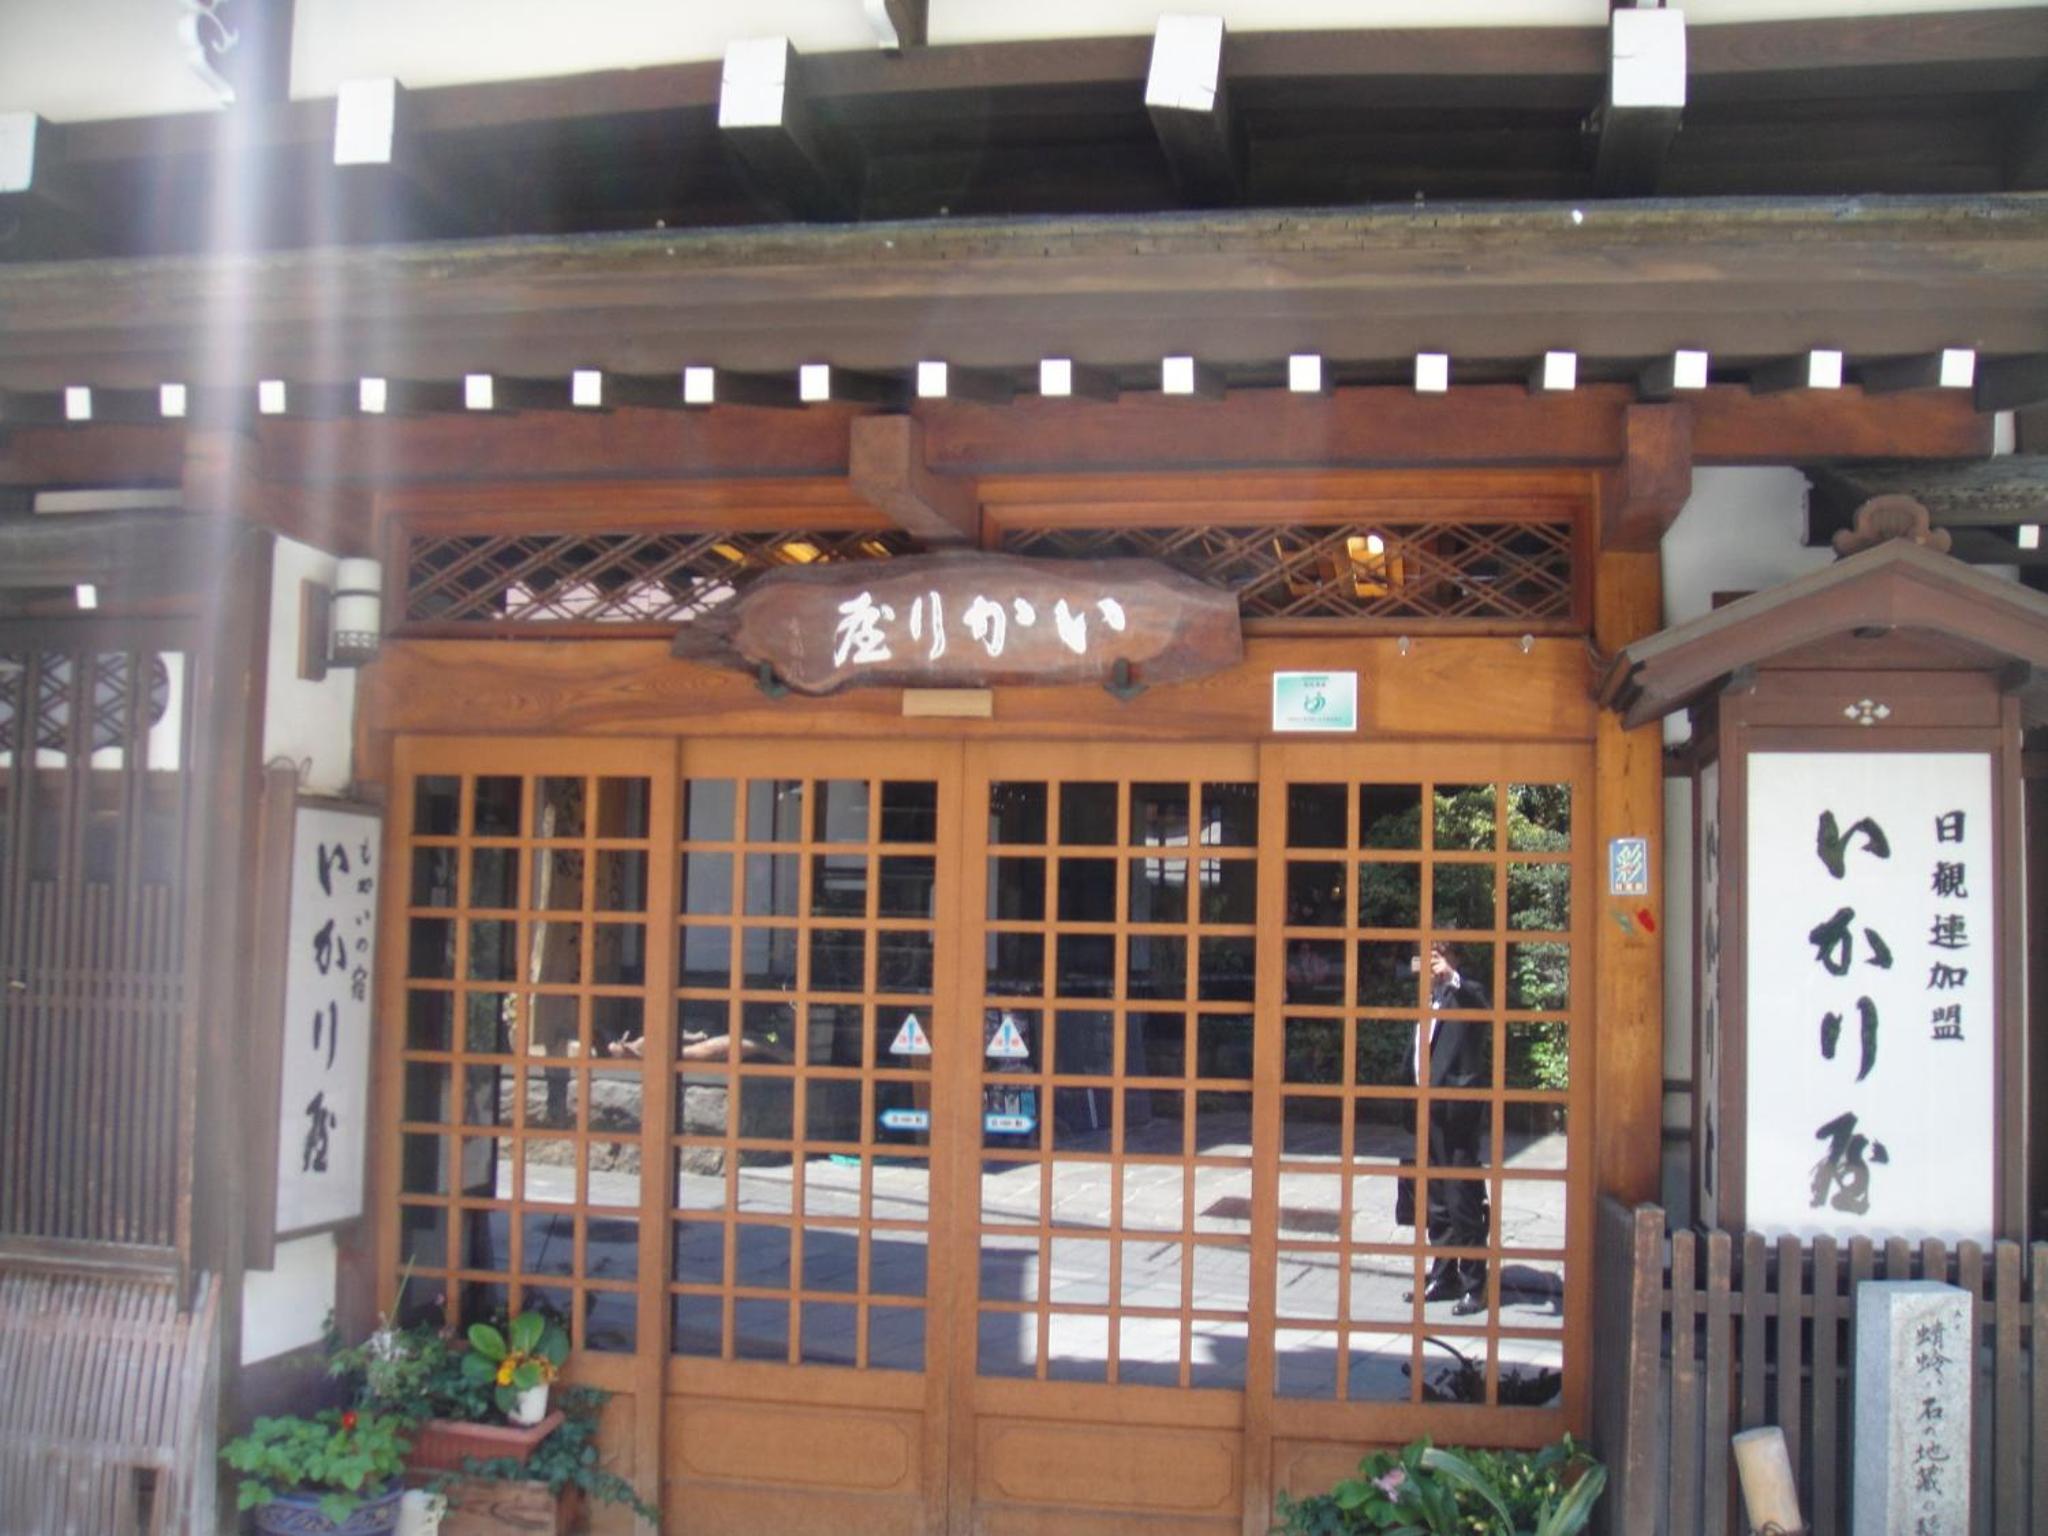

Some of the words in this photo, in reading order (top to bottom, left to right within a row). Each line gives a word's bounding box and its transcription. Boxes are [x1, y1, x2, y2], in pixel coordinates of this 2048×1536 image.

[834, 591, 1126, 668] いかり屋
[302, 842, 350, 1173] いかり屋
[1809, 810, 1894, 1215] いかり屋
[1927, 810, 1969, 1041] 日観連加盟
